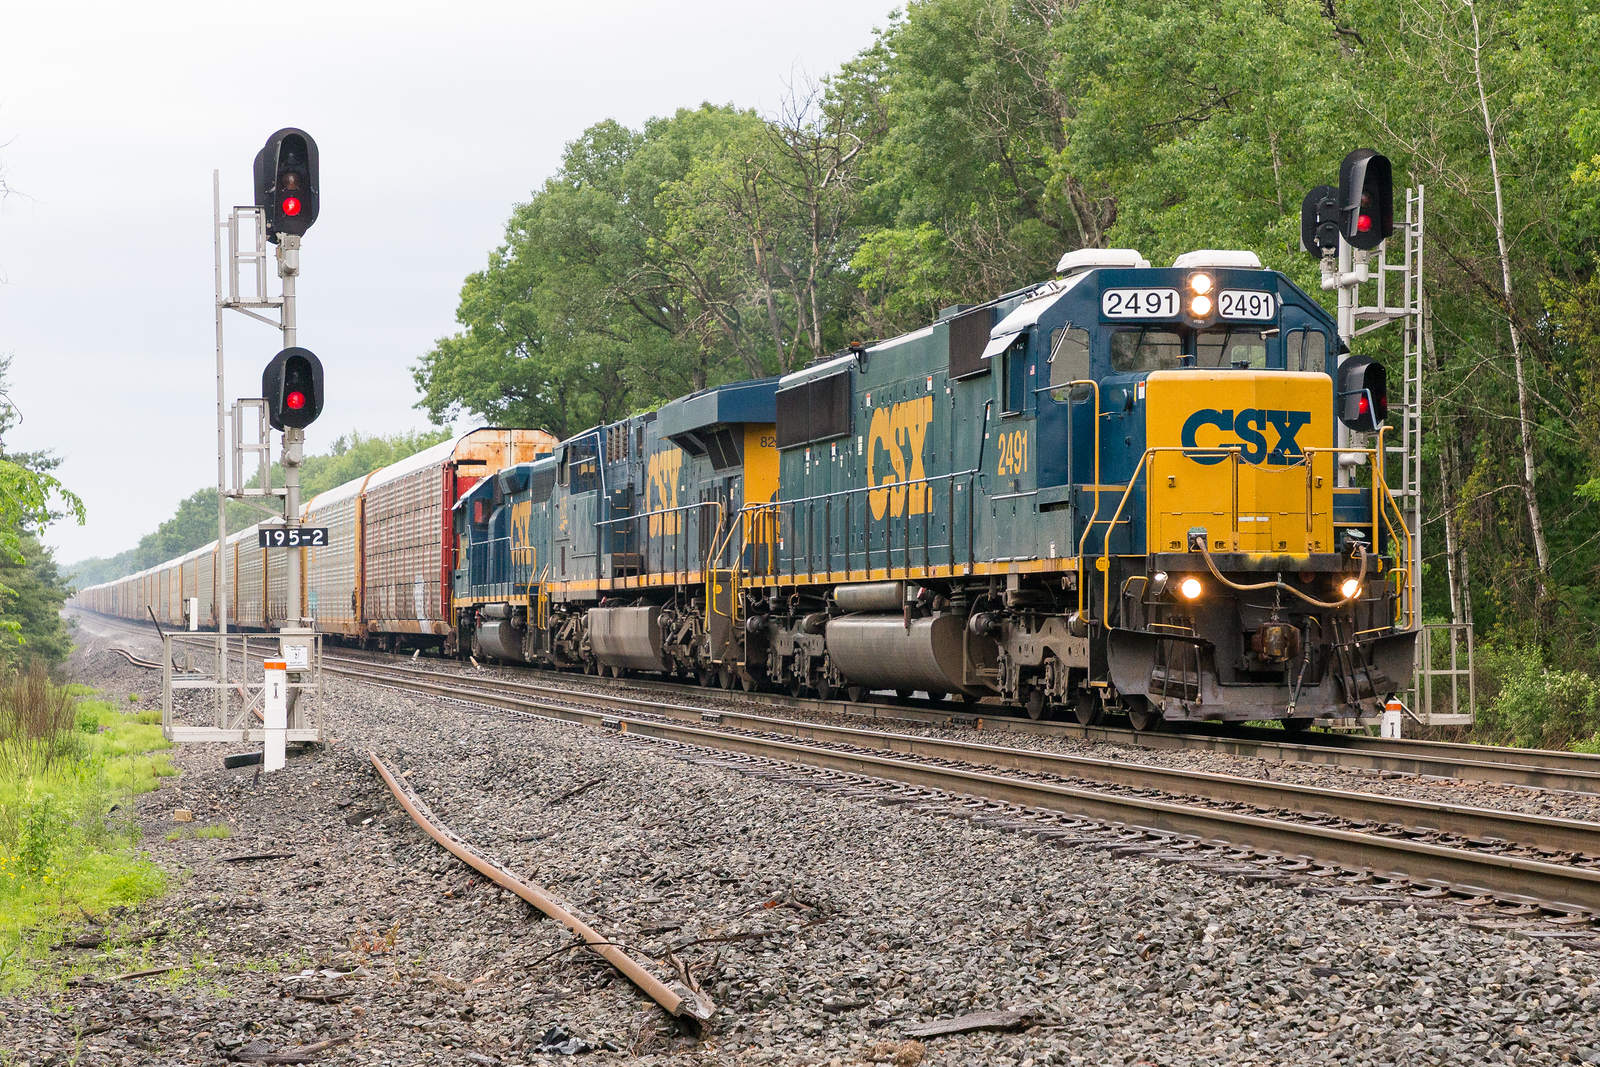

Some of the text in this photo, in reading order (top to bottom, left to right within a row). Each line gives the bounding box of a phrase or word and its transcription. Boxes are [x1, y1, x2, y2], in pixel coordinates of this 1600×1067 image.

[1107, 292, 1174, 315] 2491
[1221, 294, 1270, 318] 2491
[867, 395, 933, 521] CSX
[997, 430, 1028, 476] 2491
[1181, 408, 1311, 467] CSX
[646, 447, 682, 538] CSX
[265, 529, 324, 546] 195-2
[510, 500, 532, 567] CSX
